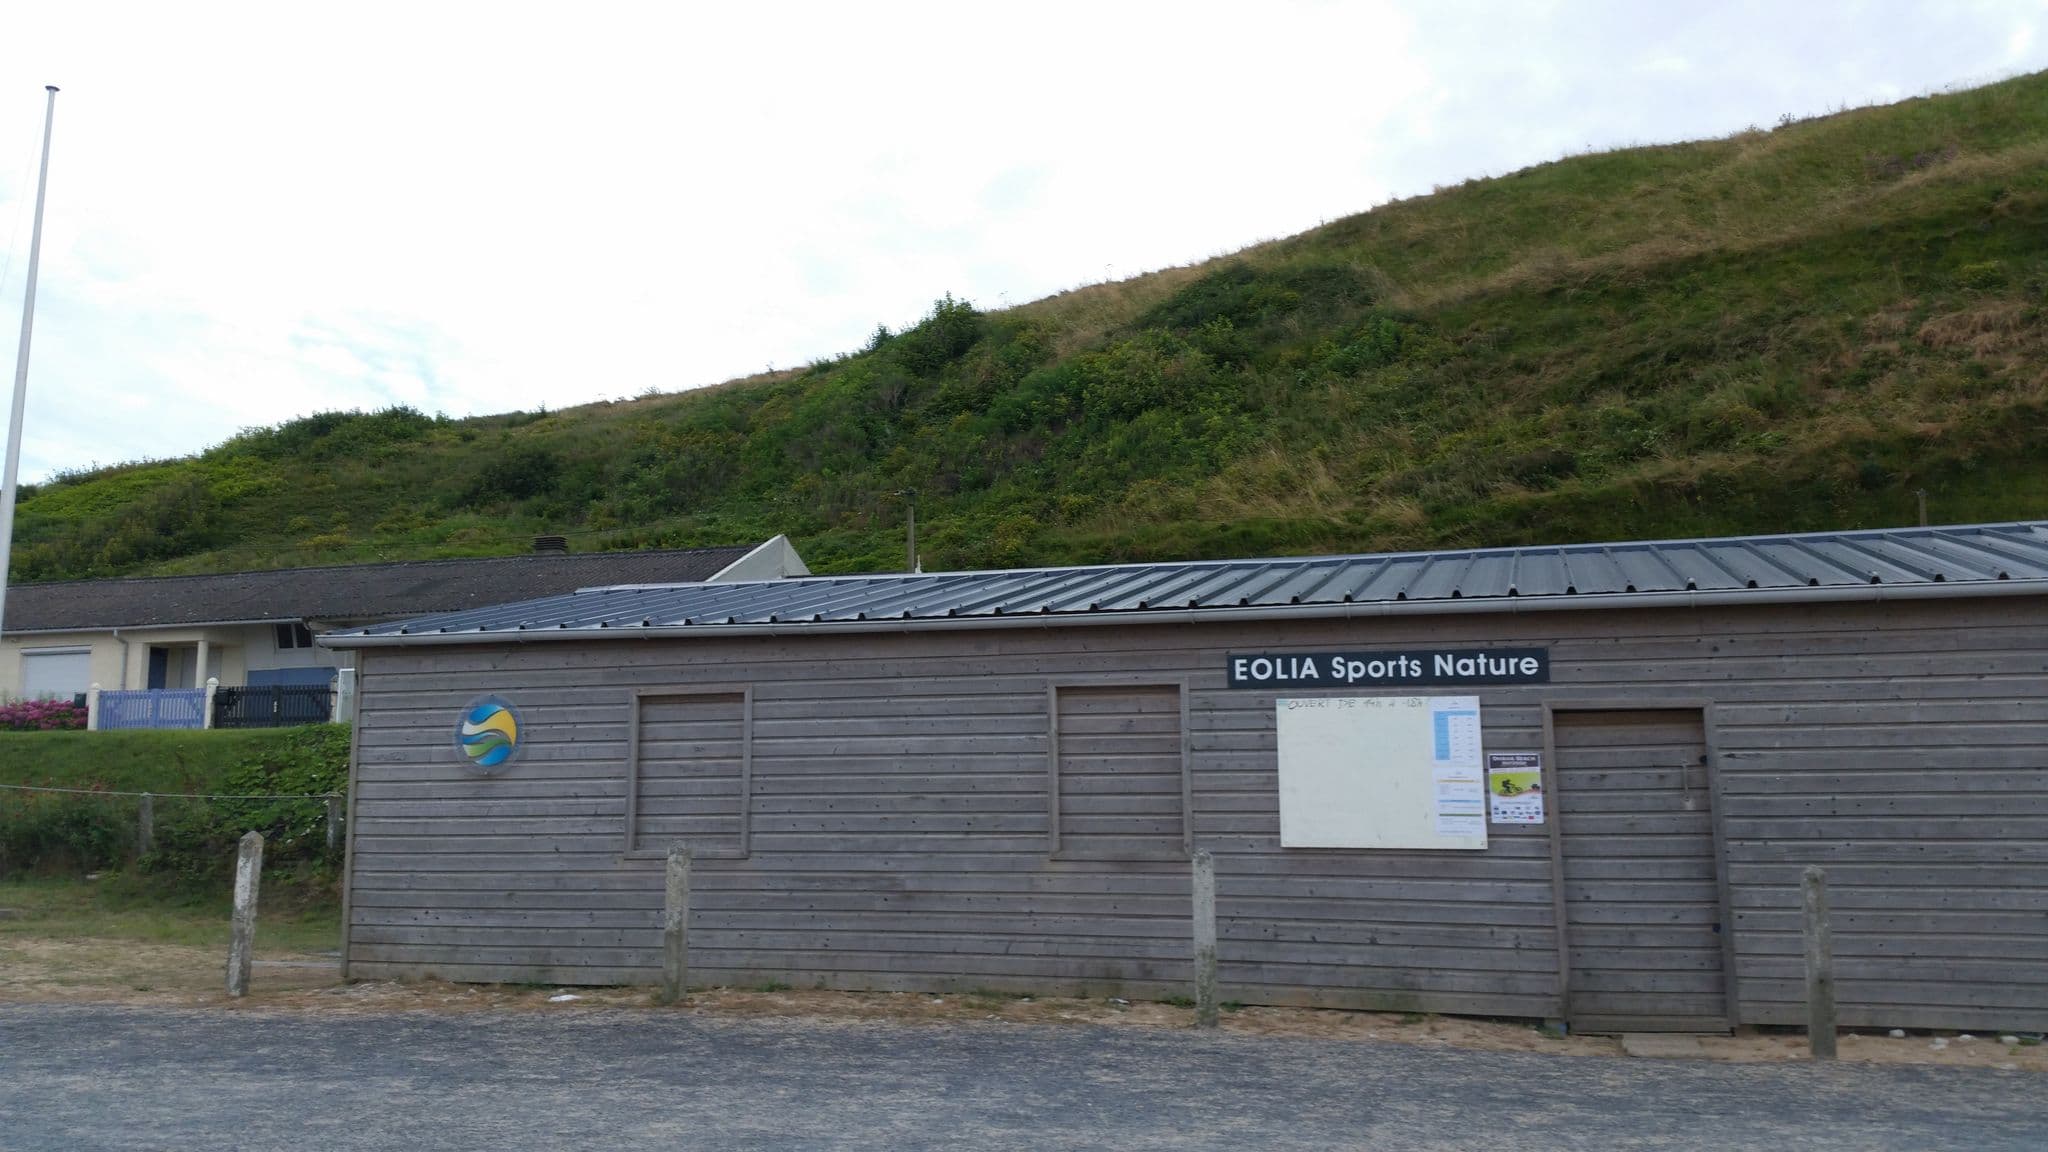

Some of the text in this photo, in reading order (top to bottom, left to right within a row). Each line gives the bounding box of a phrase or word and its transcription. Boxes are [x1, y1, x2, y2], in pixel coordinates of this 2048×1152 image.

[1234, 653, 1539, 683] EOLIA Sports Nature
